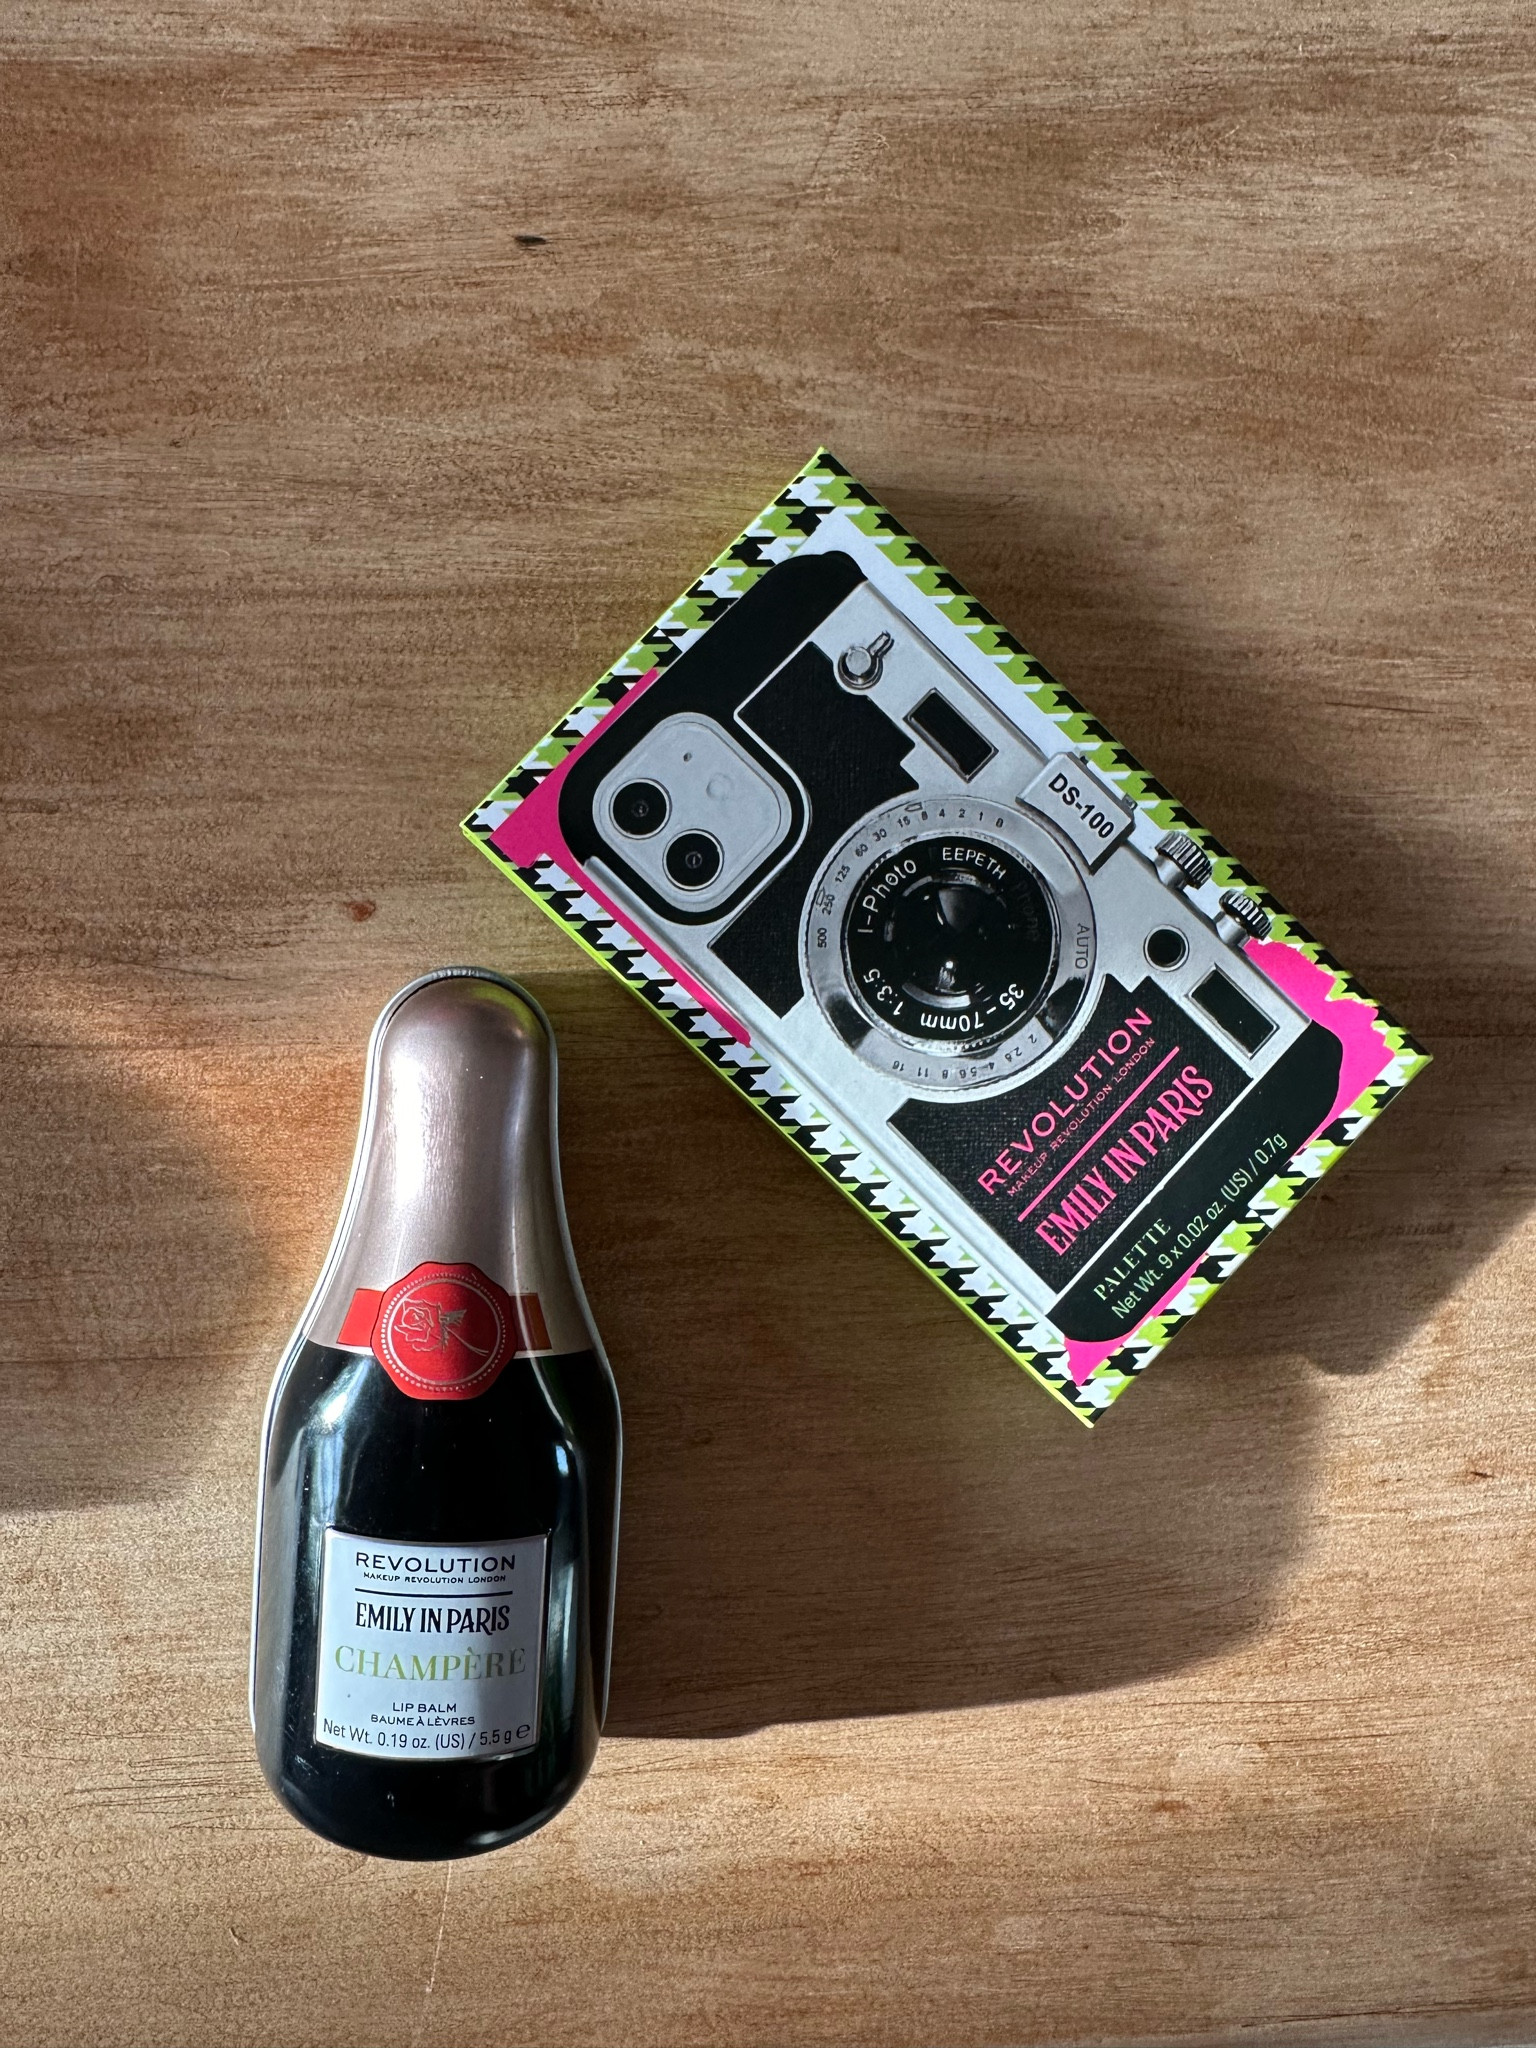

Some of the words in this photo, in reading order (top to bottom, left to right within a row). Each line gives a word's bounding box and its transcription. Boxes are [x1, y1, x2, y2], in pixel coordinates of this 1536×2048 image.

[939, 808, 944, 818] 4
[958, 808, 965, 818] 2
[1048, 773, 1114, 838] DS-100
[872, 828, 887, 842] 30
[855, 844, 868, 858] 60
[835, 865, 851, 883] 125
[822, 894, 836, 916] 250
[818, 928, 827, 948] 500
[1074, 923, 1091, 969] AUTO
[1028, 1034, 1037, 1044] 2
[892, 1060, 904, 1072] 16
[918, 1067, 928, 1078] 11
[988, 1062, 994, 1070] 4
[978, 1008, 1152, 1196] REVOLUTION
[1006, 1152, 1049, 1197] MAKEUP
[1050, 1084, 1112, 1150] REVOLUTION
[1114, 1037, 1156, 1084] LONDON
[1254, 1133, 1288, 1166] 0.7g
[1034, 1166, 1118, 1256] EMILY
[1102, 1140, 1145, 1184] IN
[1128, 1064, 1214, 1156] PARIS
[1252, 1158, 1260, 1176] /
[1220, 1168, 1252, 1204] (US)
[1206, 1201, 1227, 1224] oz.
[1178, 1216, 1210, 1248] 0.02
[1093, 1218, 1172, 1302] PALETTE
[1162, 1253, 1174, 1269] 9
[1172, 1244, 1182, 1258] x
[1136, 1270, 1164, 1298] Wt.
[1112, 1290, 1142, 1319] Net
[356, 1552, 516, 1572] REVOLUTION
[364, 1572, 400, 1582] MAKEUP
[404, 1576, 464, 1584] REVOLUTION
[468, 1575, 506, 1584] LONDON
[356, 1602, 416, 1632] EMILY
[420, 1609, 442, 1632] IN
[446, 1605, 510, 1636] PARIS
[335, 1645, 526, 1681] CHAMPÈRE
[392, 1703, 414, 1712] LIP
[418, 1703, 457, 1713] BALM
[370, 1714, 414, 1726] BAUME
[414, 1714, 424, 1726] À
[427, 1715, 476, 1726] LÈVRES
[324, 1718, 346, 1738] Net
[349, 1729, 373, 1744] Wt.
[378, 1732, 407, 1748] 0.19
[412, 1737, 430, 1748] oz.
[436, 1734, 465, 1750] (US)
[469, 1732, 476, 1748] /
[480, 1729, 500, 1746] 5.5
[504, 1731, 512, 1744] g
